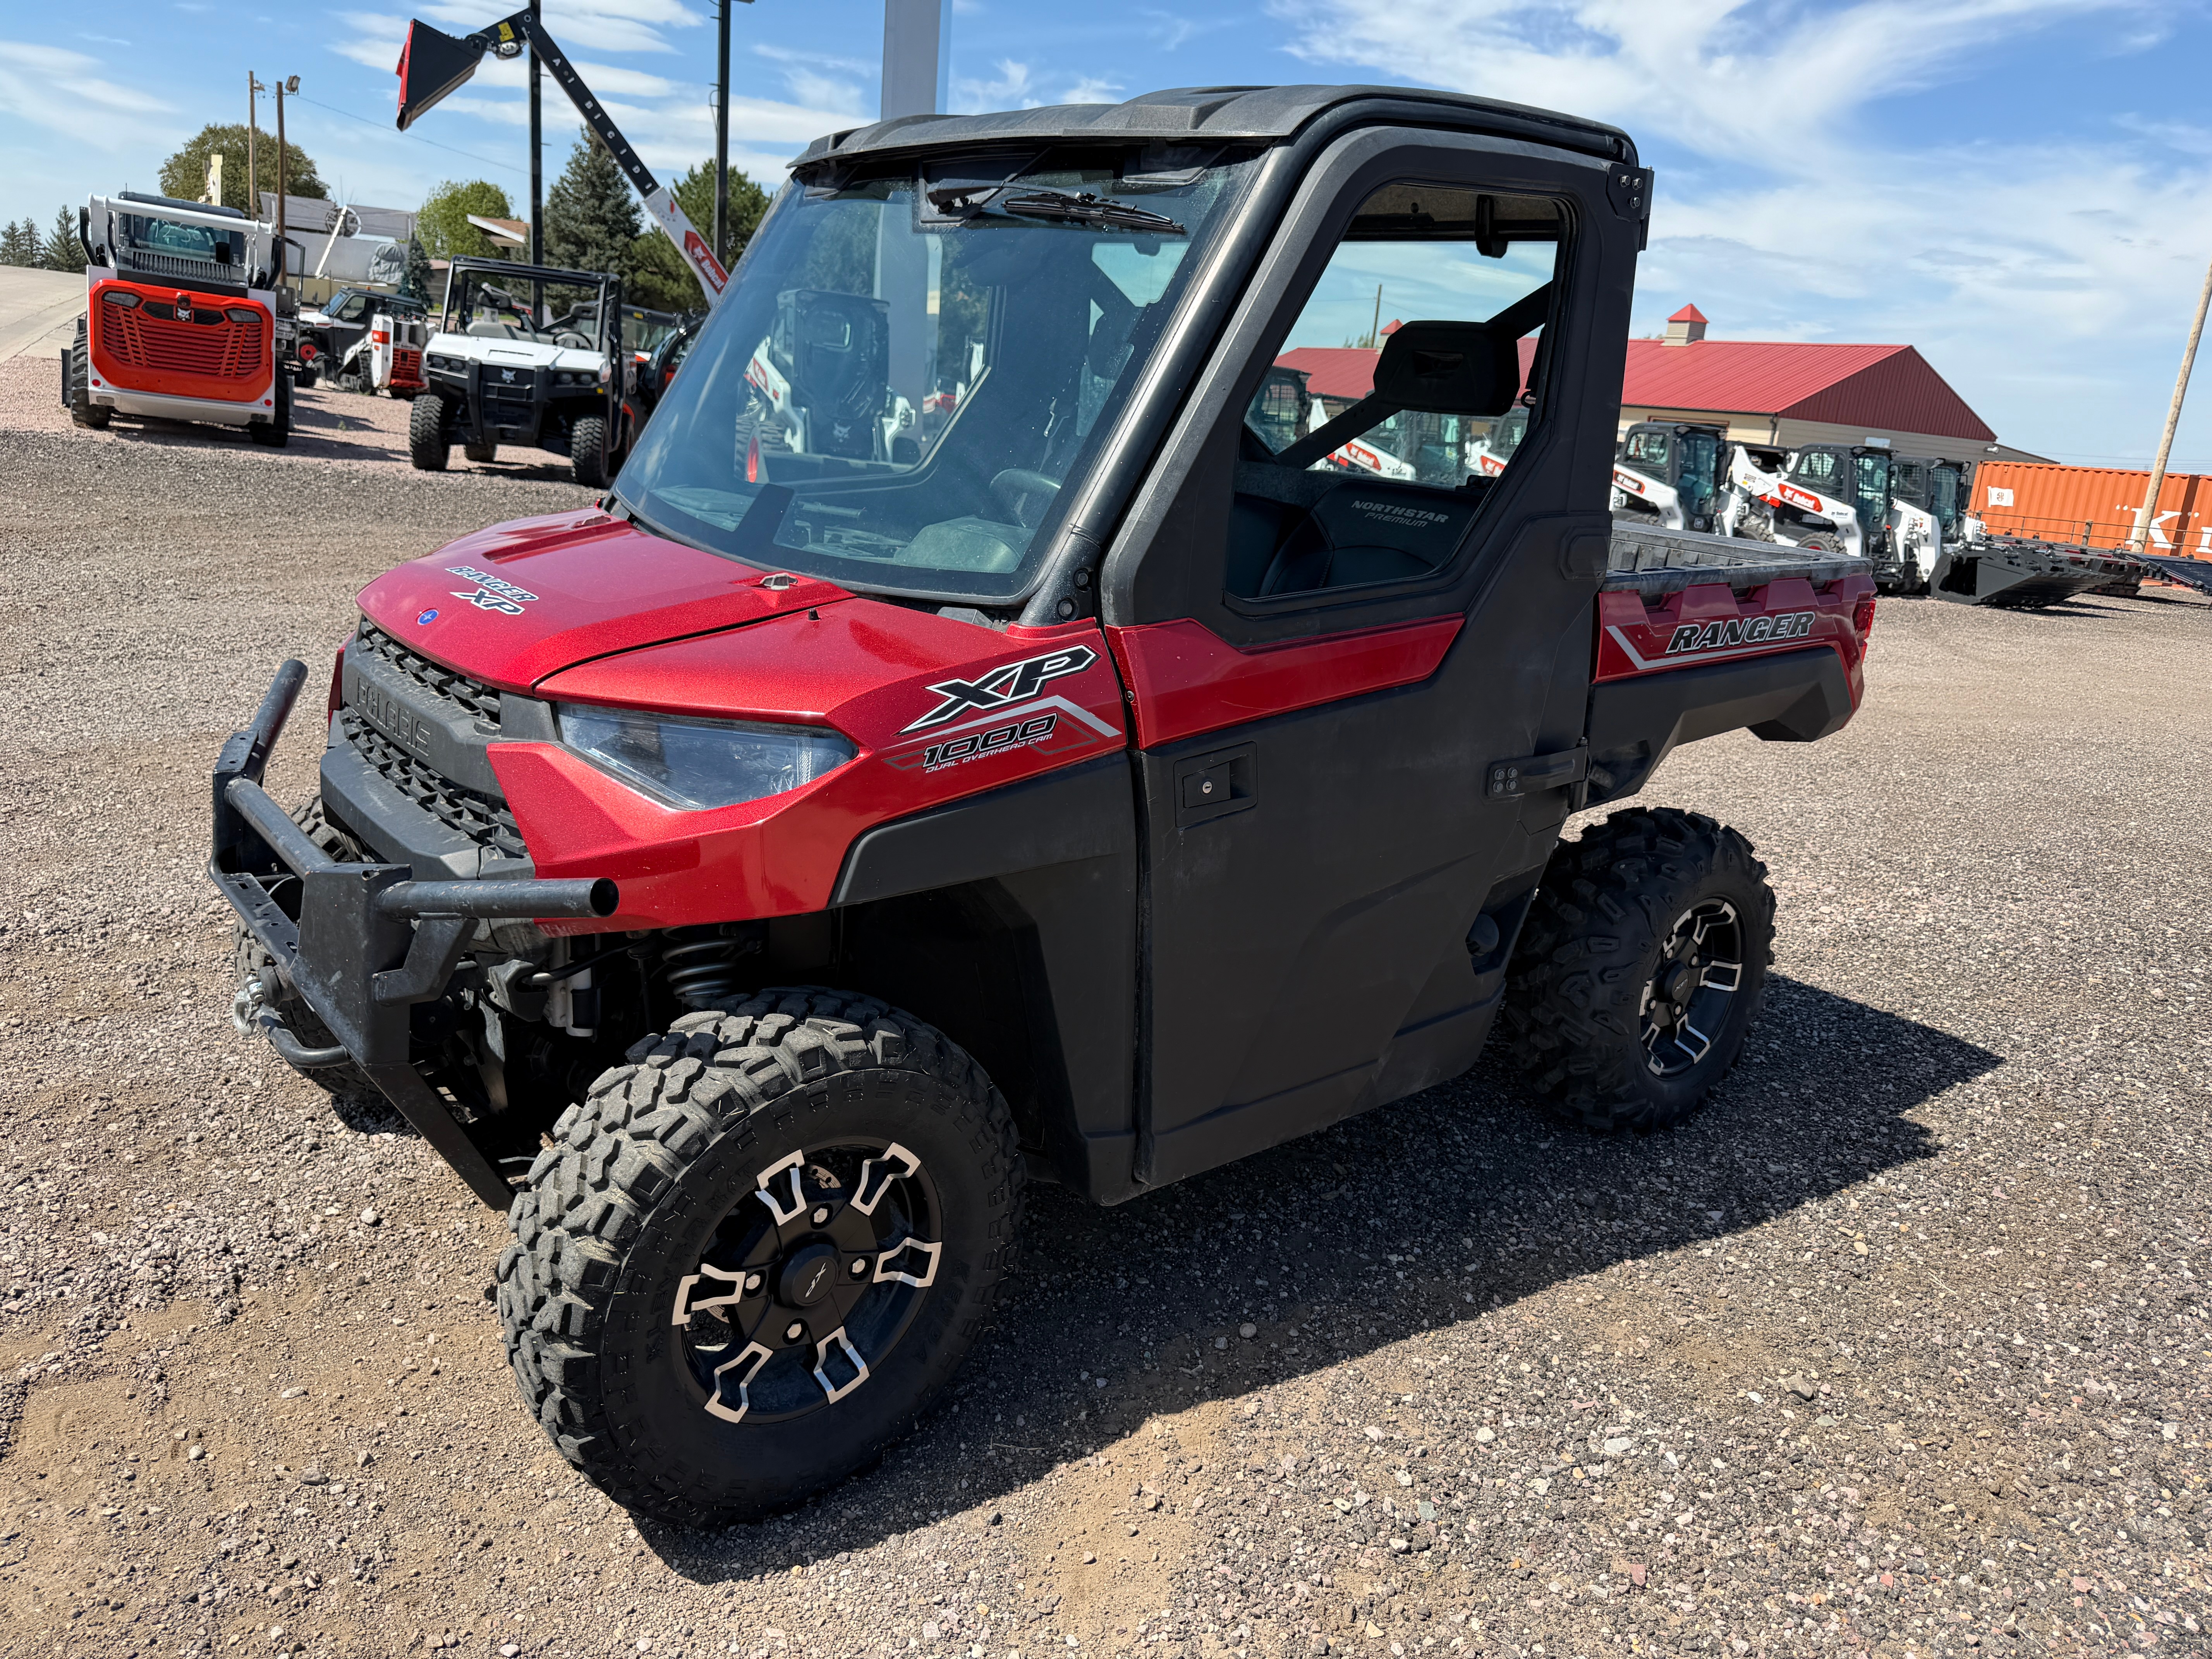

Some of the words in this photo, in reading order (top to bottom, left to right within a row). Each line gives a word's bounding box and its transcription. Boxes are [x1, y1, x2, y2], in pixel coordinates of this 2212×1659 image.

[701, 259, 725, 289] Bobcat
[1351, 500, 1449, 523] NORTHSTAR
[1364, 512, 1428, 527] PREMIUM
[1793, 493, 1815, 509] Bobcat
[445, 565, 539, 602] RANGER
[450, 587, 525, 615] XP
[1665, 611, 1815, 654] RANGER
[896, 644, 1101, 735] XP
[357, 677, 431, 756] POLARIS
[922, 713, 1058, 769] 1000
[925, 761, 959, 774] DUAL
[962, 742, 1025, 763] OVERHEAD
[1028, 733, 1053, 745] CAM
